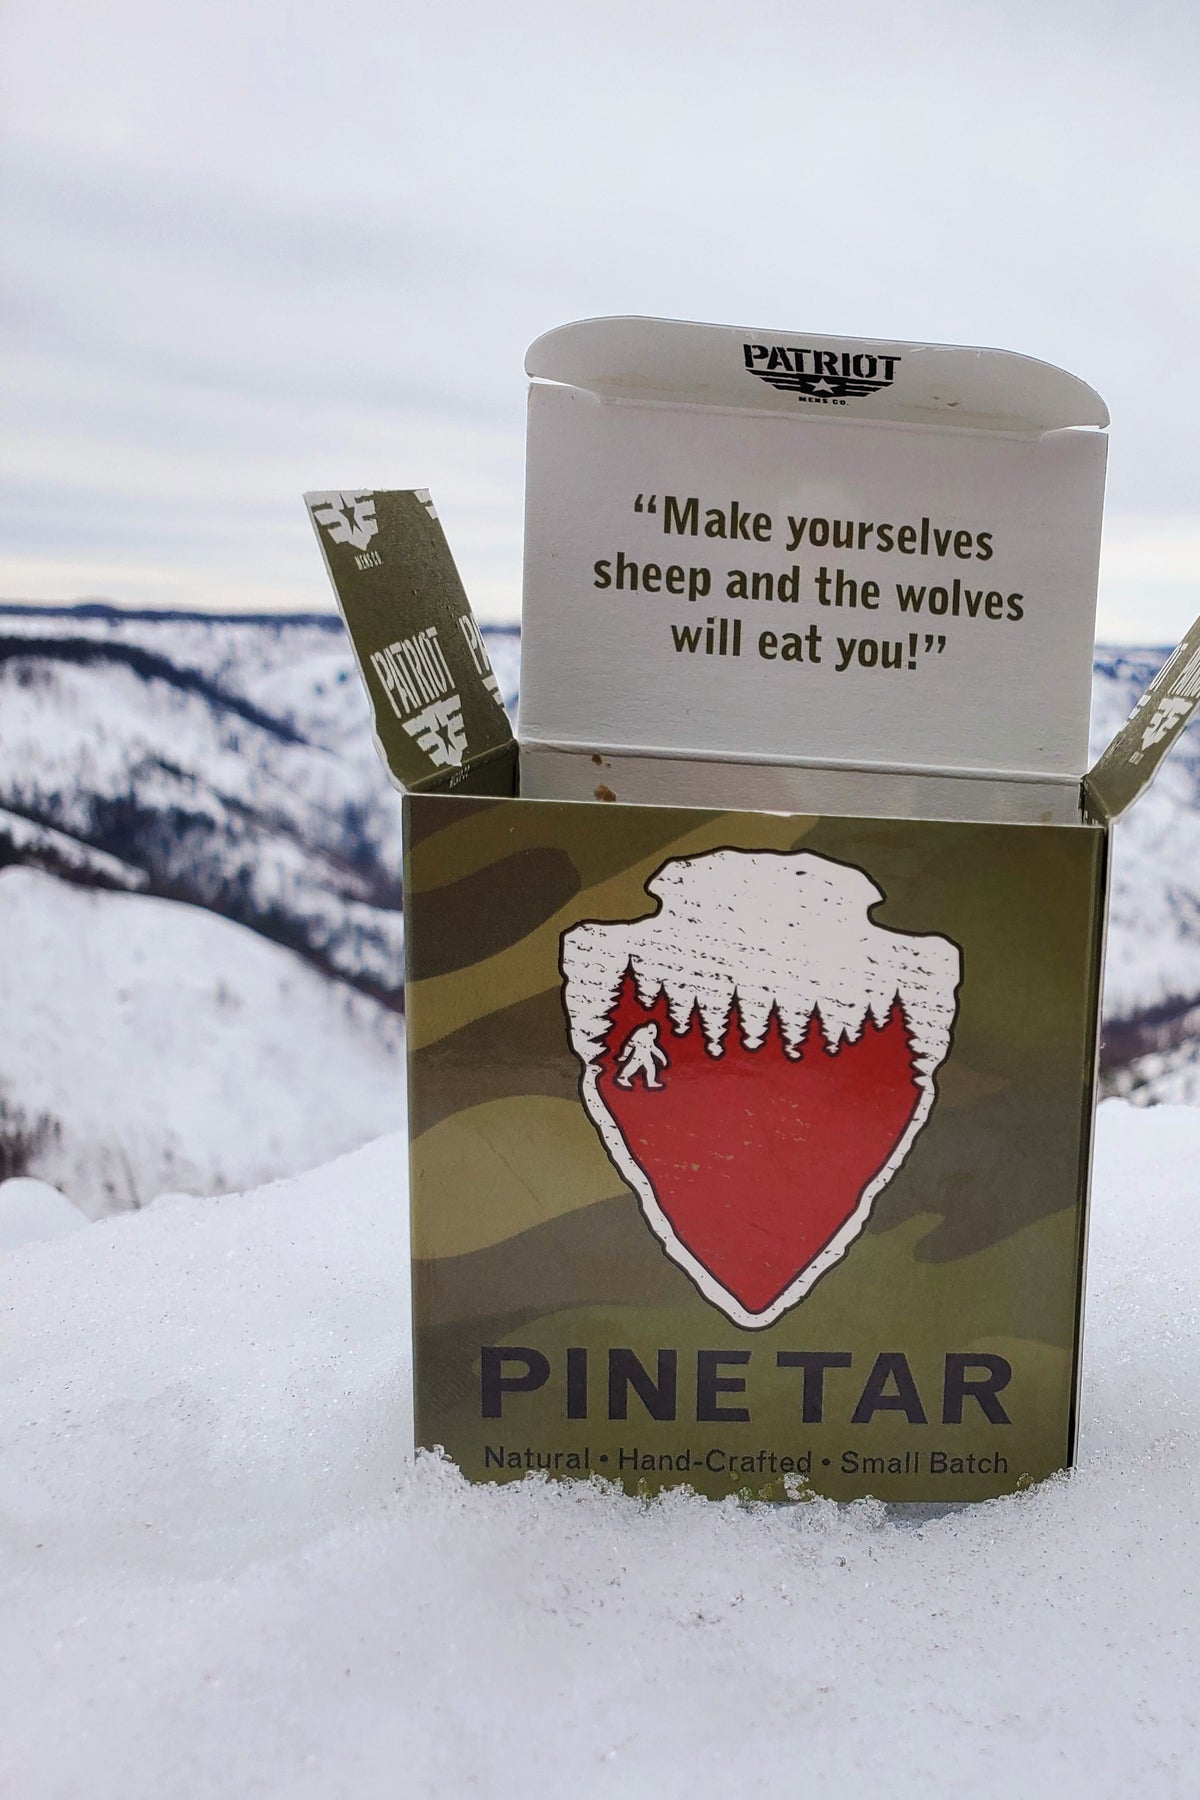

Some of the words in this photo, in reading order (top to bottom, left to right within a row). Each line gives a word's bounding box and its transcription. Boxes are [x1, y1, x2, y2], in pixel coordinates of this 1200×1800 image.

[743, 343, 902, 381] PATRIOT
[798, 396, 829, 404] MENS
[632, 493, 773, 542] “Make
[786, 517, 994, 561] yourselves
[593, 551, 712, 601] sheep
[726, 565, 800, 603] and
[814, 566, 881, 610] the
[896, 578, 1025, 621] wolves
[370, 626, 456, 720] PATRIOT
[670, 616, 742, 657] will
[757, 624, 822, 663] eat
[834, 633, 947, 672] you!”
[480, 1346, 752, 1422] PINE
[775, 1351, 1013, 1425] TAR
[484, 1445, 590, 1471] Natural
[618, 1447, 812, 1474] Hand-Crafted
[840, 1450, 919, 1475] Small
[929, 1450, 1009, 1474] Batch
